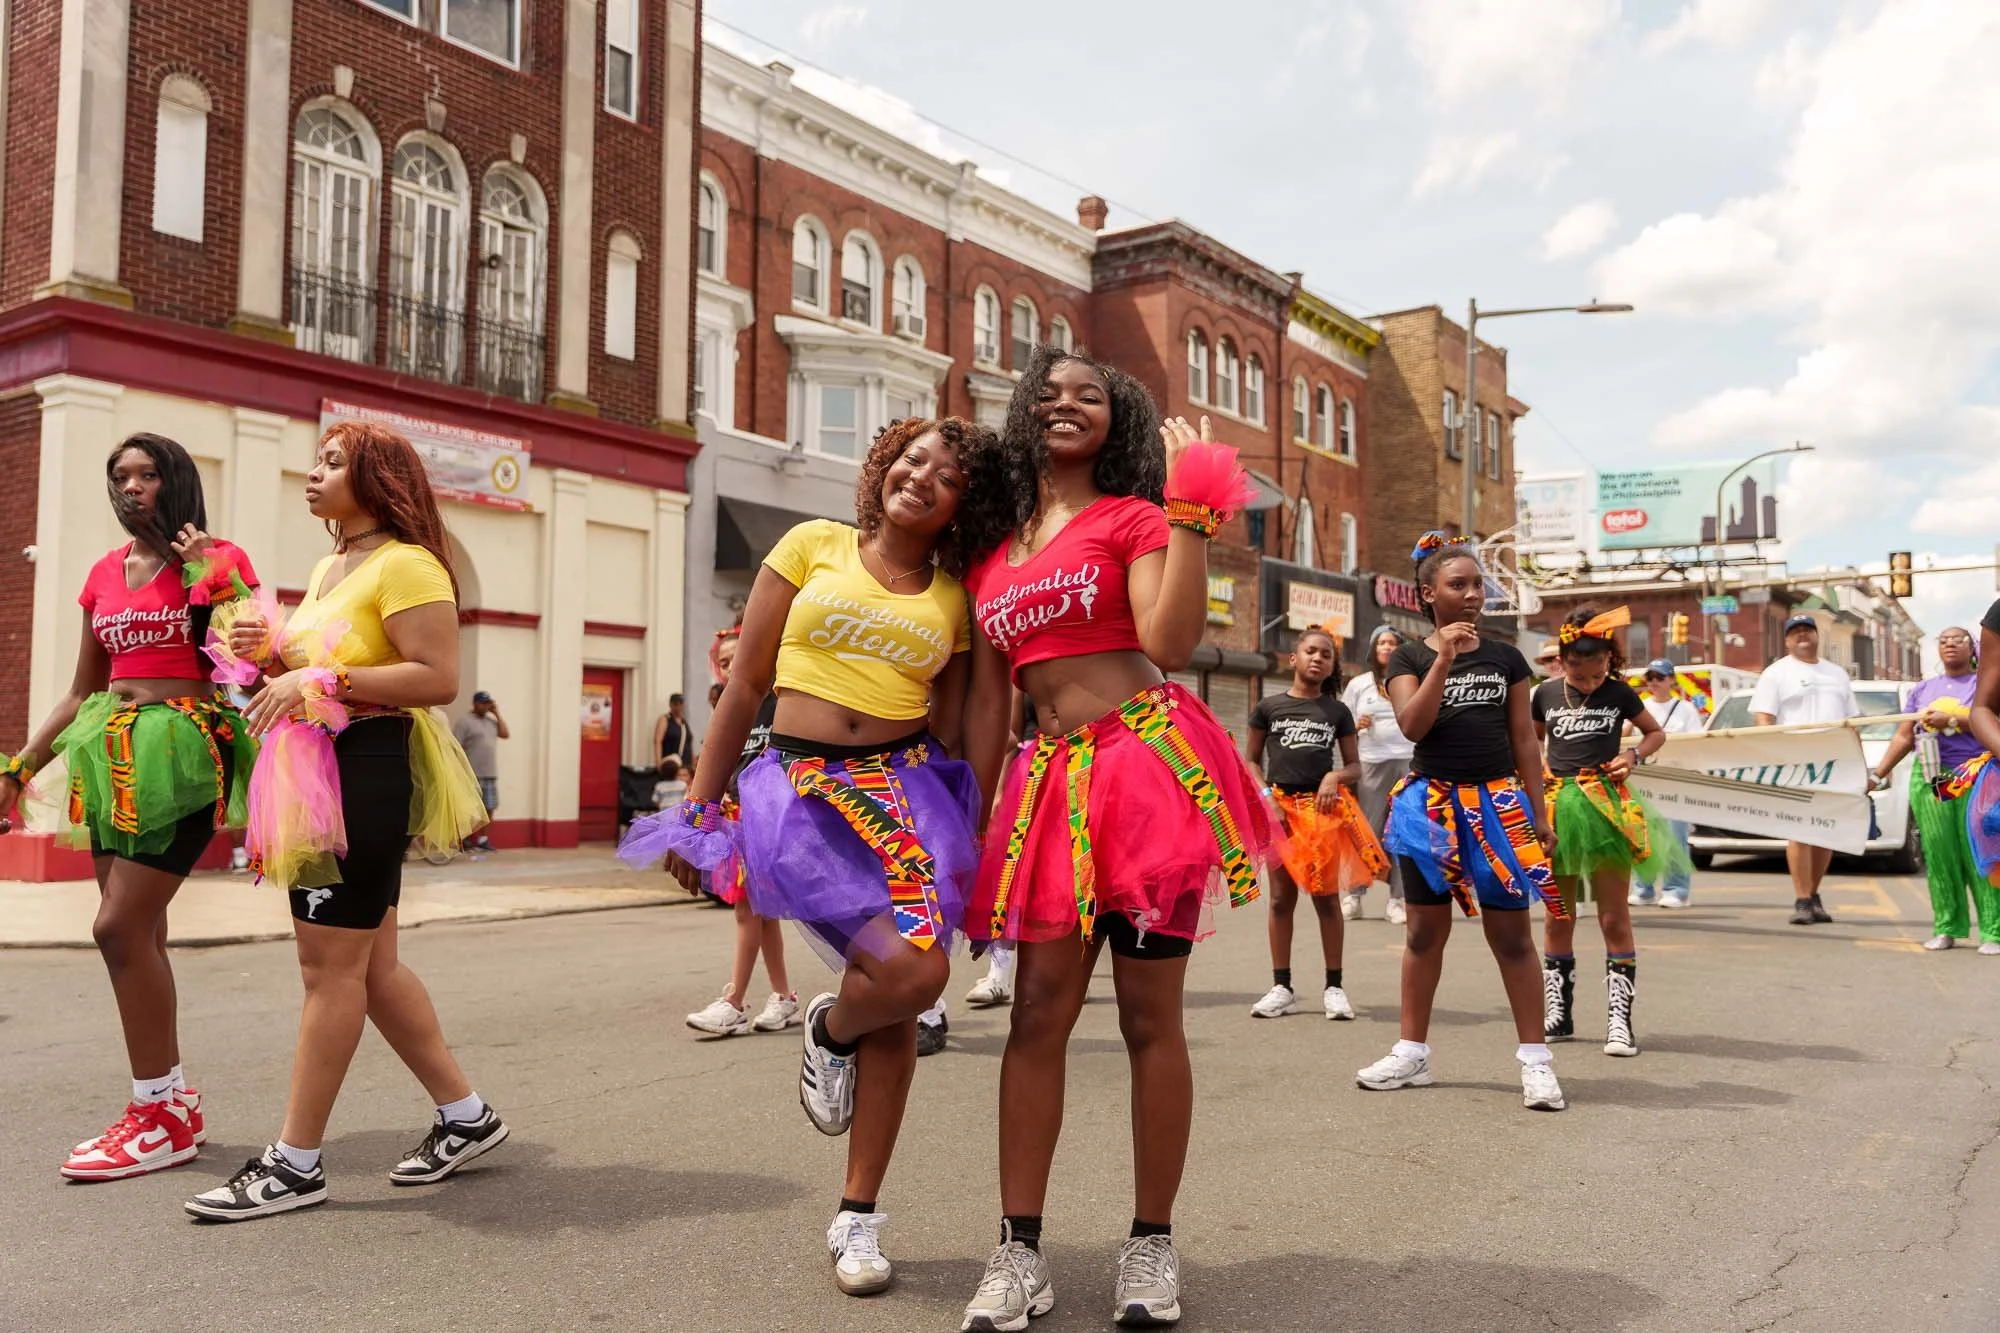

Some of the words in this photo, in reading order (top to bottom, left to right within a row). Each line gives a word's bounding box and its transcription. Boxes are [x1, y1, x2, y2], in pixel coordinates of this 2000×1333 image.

[333, 403, 358, 419] THE
[477, 431, 522, 450] CHURCH
[1606, 509, 1643, 529] total
[1290, 587, 1318, 609] CHINA
[1320, 592, 1350, 615] HOUSE
[1659, 792, 1679, 804] and
[1684, 795, 1720, 809] human
[1727, 803, 1769, 818] services
[1776, 810, 1803, 824] since
[1810, 815, 1836, 830] 1967
